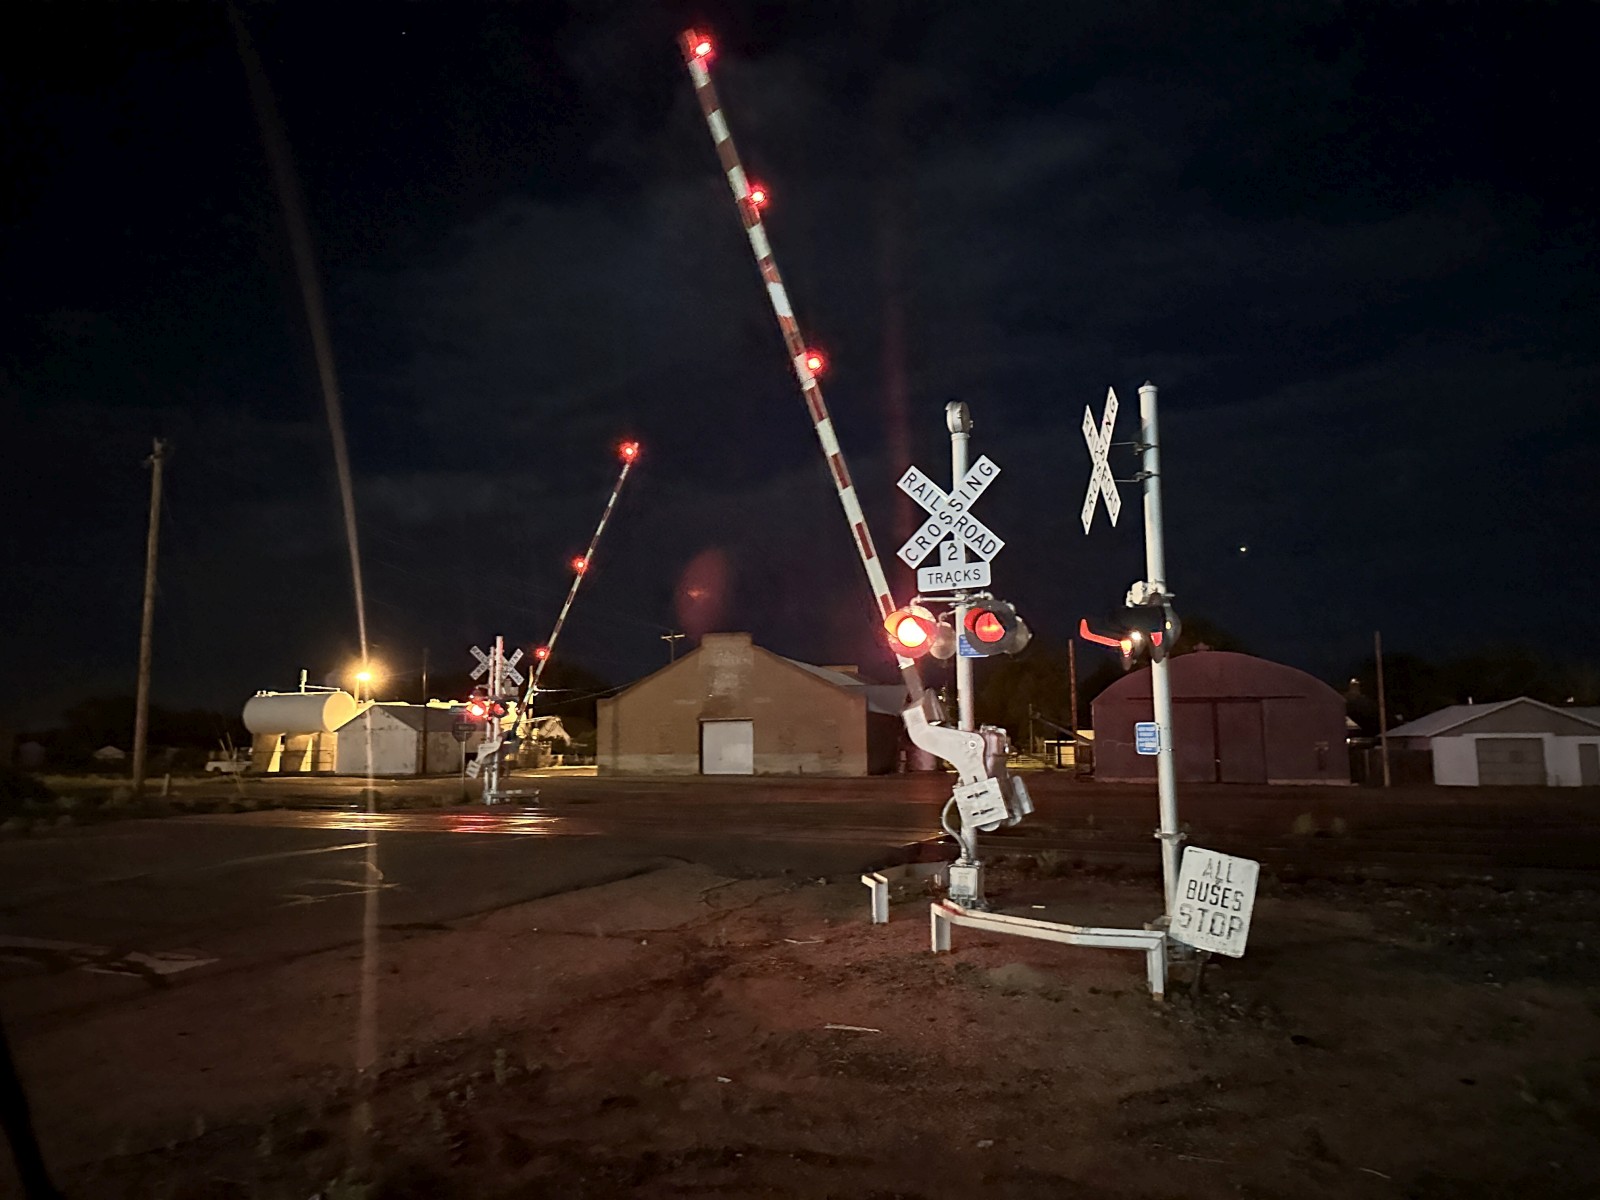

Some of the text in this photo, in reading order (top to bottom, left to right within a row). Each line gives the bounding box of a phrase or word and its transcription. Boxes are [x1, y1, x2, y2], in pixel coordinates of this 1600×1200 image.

[903, 471, 996, 555] RAILROAD
[904, 462, 994, 562] CROSSING
[947, 544, 958, 561] 2
[928, 568, 981, 585] TRACKS
[1202, 857, 1233, 884] ALL
[1186, 879, 1244, 912] BUSES
[1179, 903, 1244, 940] STOP
